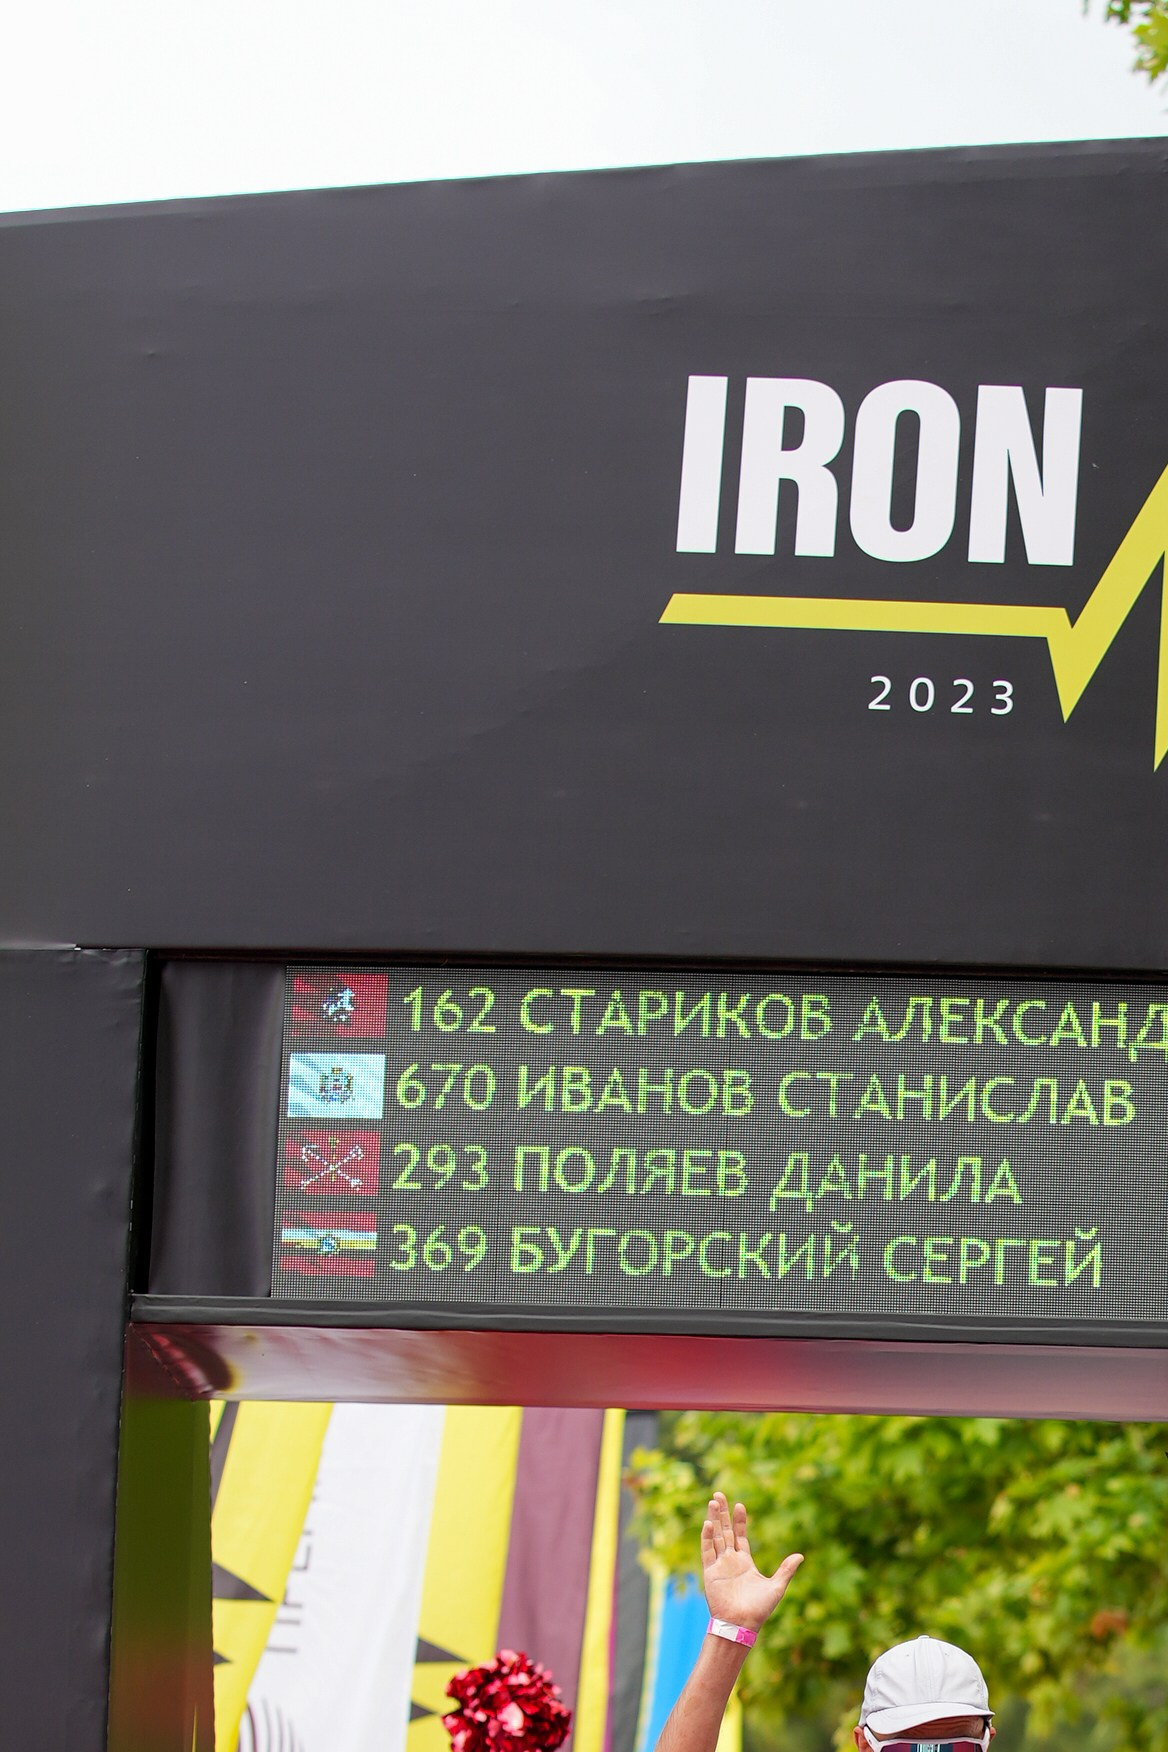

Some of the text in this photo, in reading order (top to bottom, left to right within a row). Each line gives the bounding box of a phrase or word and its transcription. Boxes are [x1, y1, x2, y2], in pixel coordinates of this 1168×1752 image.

[676, 375, 1083, 566] IRON
[868, 675, 1017, 716] 2023
[405, 986, 496, 1033] 162
[519, 988, 831, 1041] СТАРИКОВ
[396, 1063, 496, 1110] 670
[518, 1065, 754, 1117] ИВАНОВ
[777, 1071, 1136, 1126] СТАНИСЛАВ
[391, 1142, 489, 1191] 293
[513, 1145, 747, 1198] ПОЛЯЕВ
[768, 1151, 1022, 1213] ДАНИЛА
[389, 1223, 486, 1271] 369
[510, 1219, 859, 1279] БУГОРСКИЙ
[882, 1226, 1102, 1289] СЕРГЕЙ
